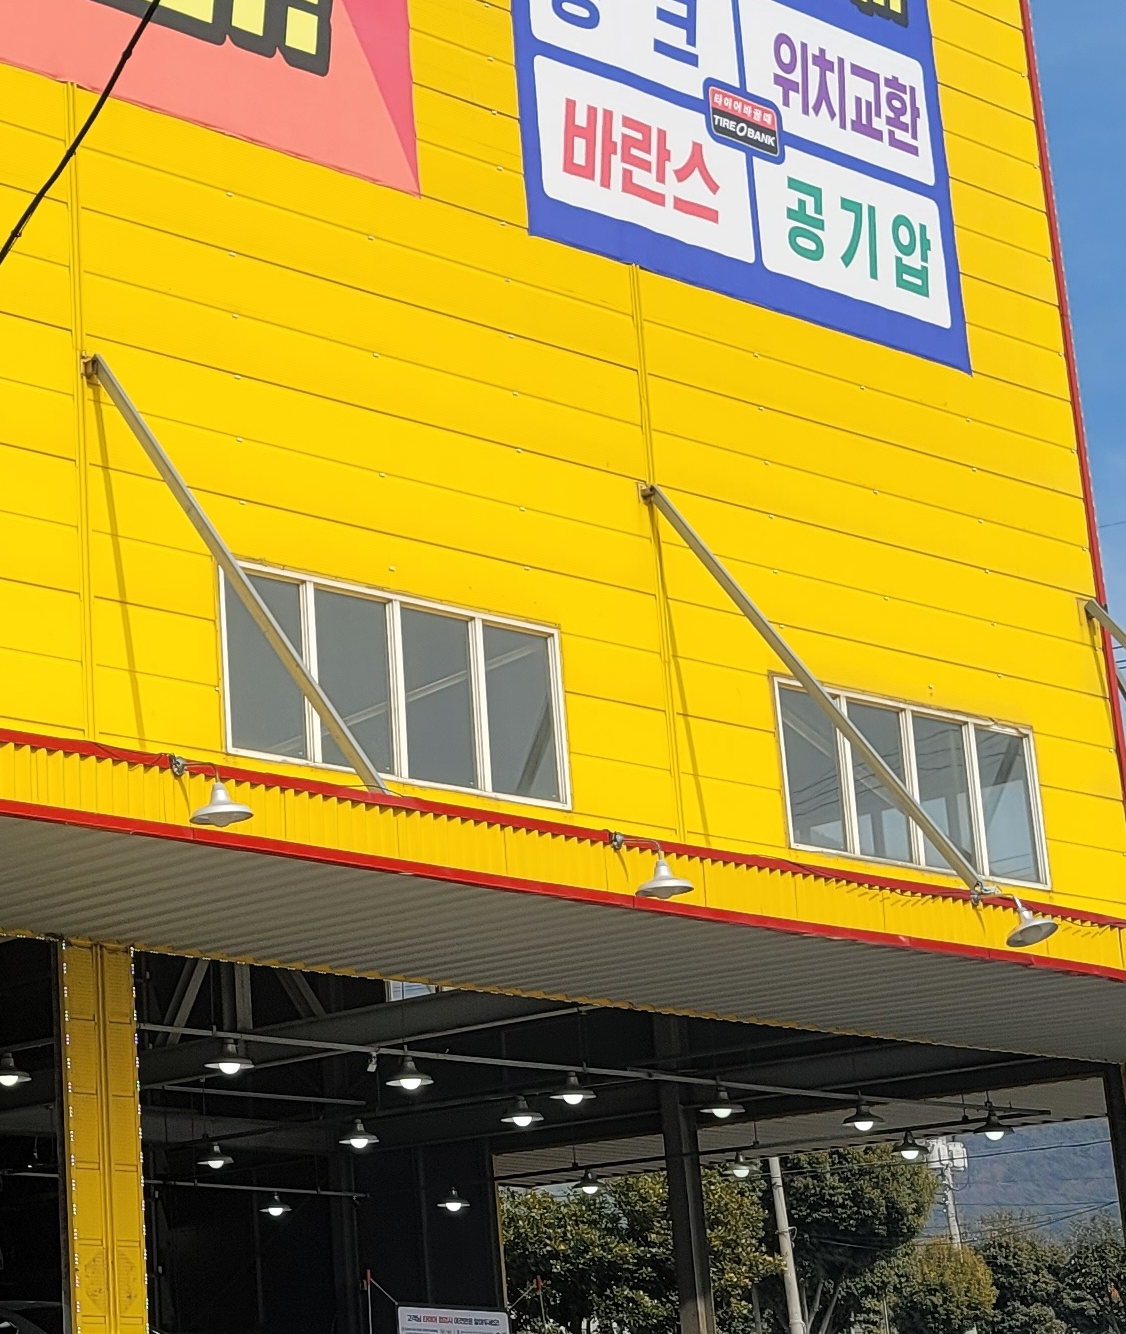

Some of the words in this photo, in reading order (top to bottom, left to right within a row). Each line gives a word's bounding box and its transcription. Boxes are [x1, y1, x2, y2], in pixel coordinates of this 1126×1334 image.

[772, 31, 921, 159] 위치교환
[561, 96, 721, 225] 바란스
[785, 173, 932, 299] 공기압
